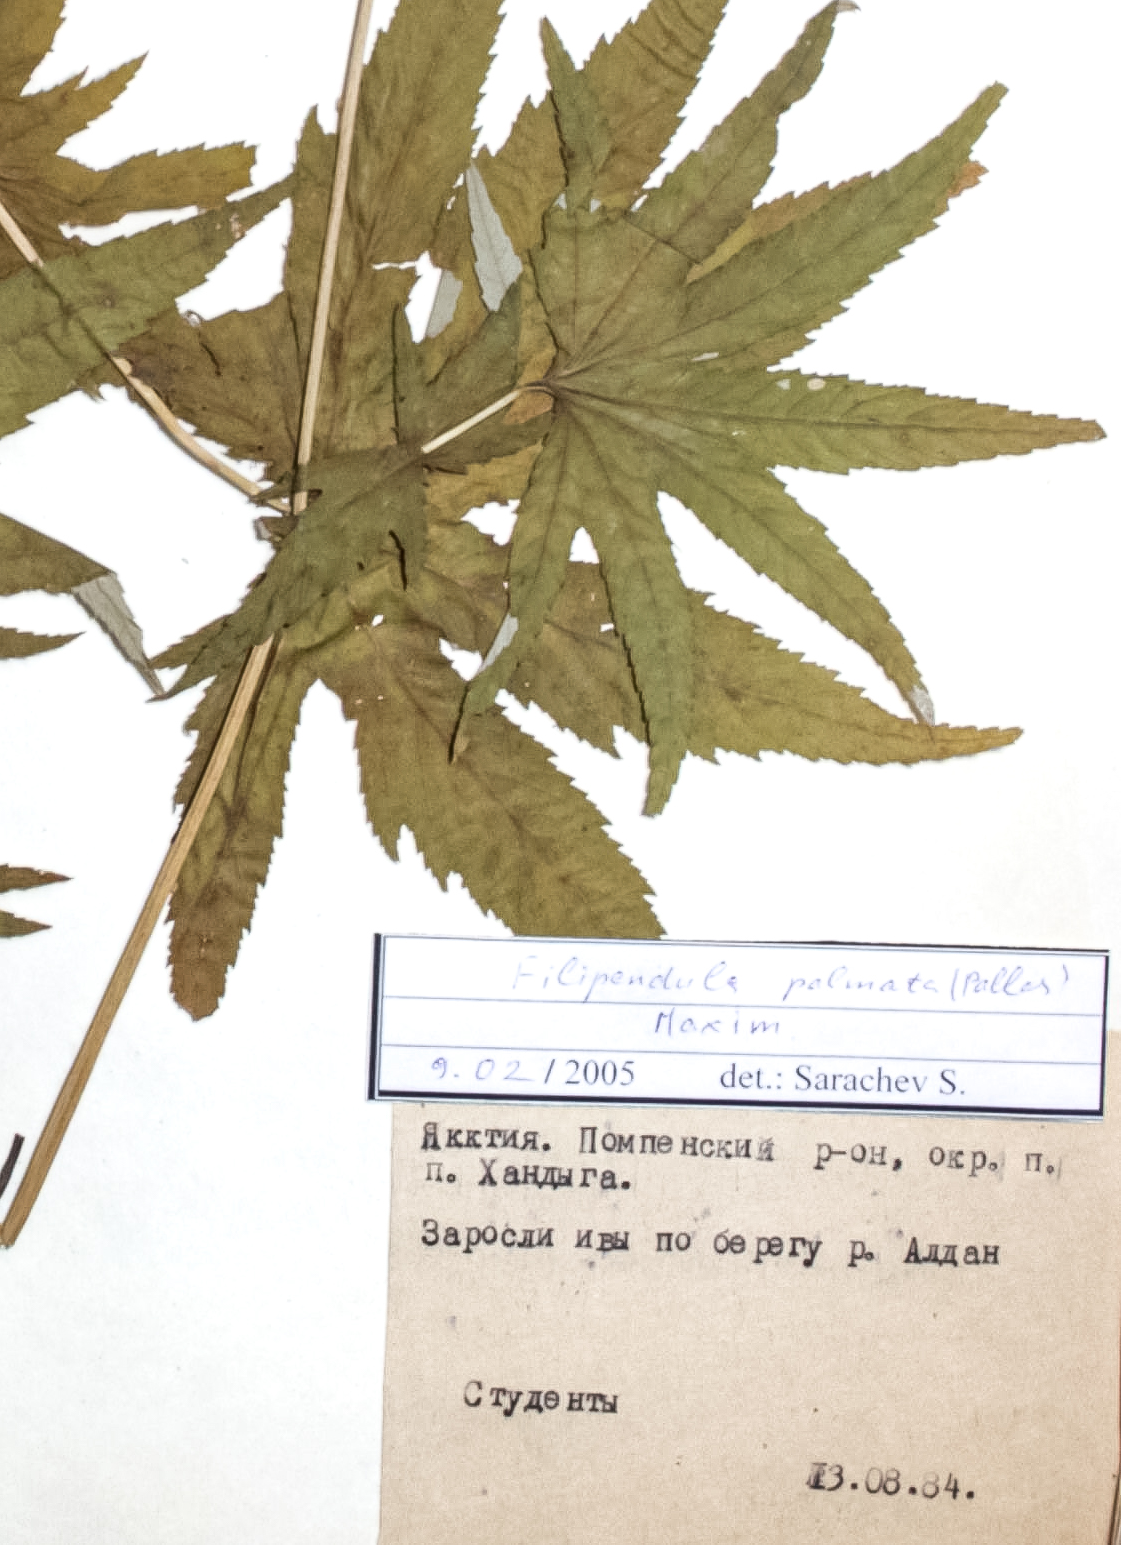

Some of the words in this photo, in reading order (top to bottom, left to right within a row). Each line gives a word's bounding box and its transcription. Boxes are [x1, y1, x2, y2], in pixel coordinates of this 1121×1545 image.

[719, 1062, 783, 1091] det.:
[794, 1064, 928, 1094] Sarachev
[939, 1068, 967, 1096] S.
[813, 1142, 904, 1171] р-он,
[426, 1161, 457, 1184] п.
[478, 1158, 631, 1191] Хандыга.
[421, 1218, 554, 1253] Заросли
[575, 1228, 630, 1252] ивы
[656, 1231, 692, 1252] по
[714, 1228, 824, 1268] берегу
[847, 1239, 875, 1268] р.
[903, 1236, 1001, 1267] Алдан
[463, 1379, 619, 1418] Студенты
